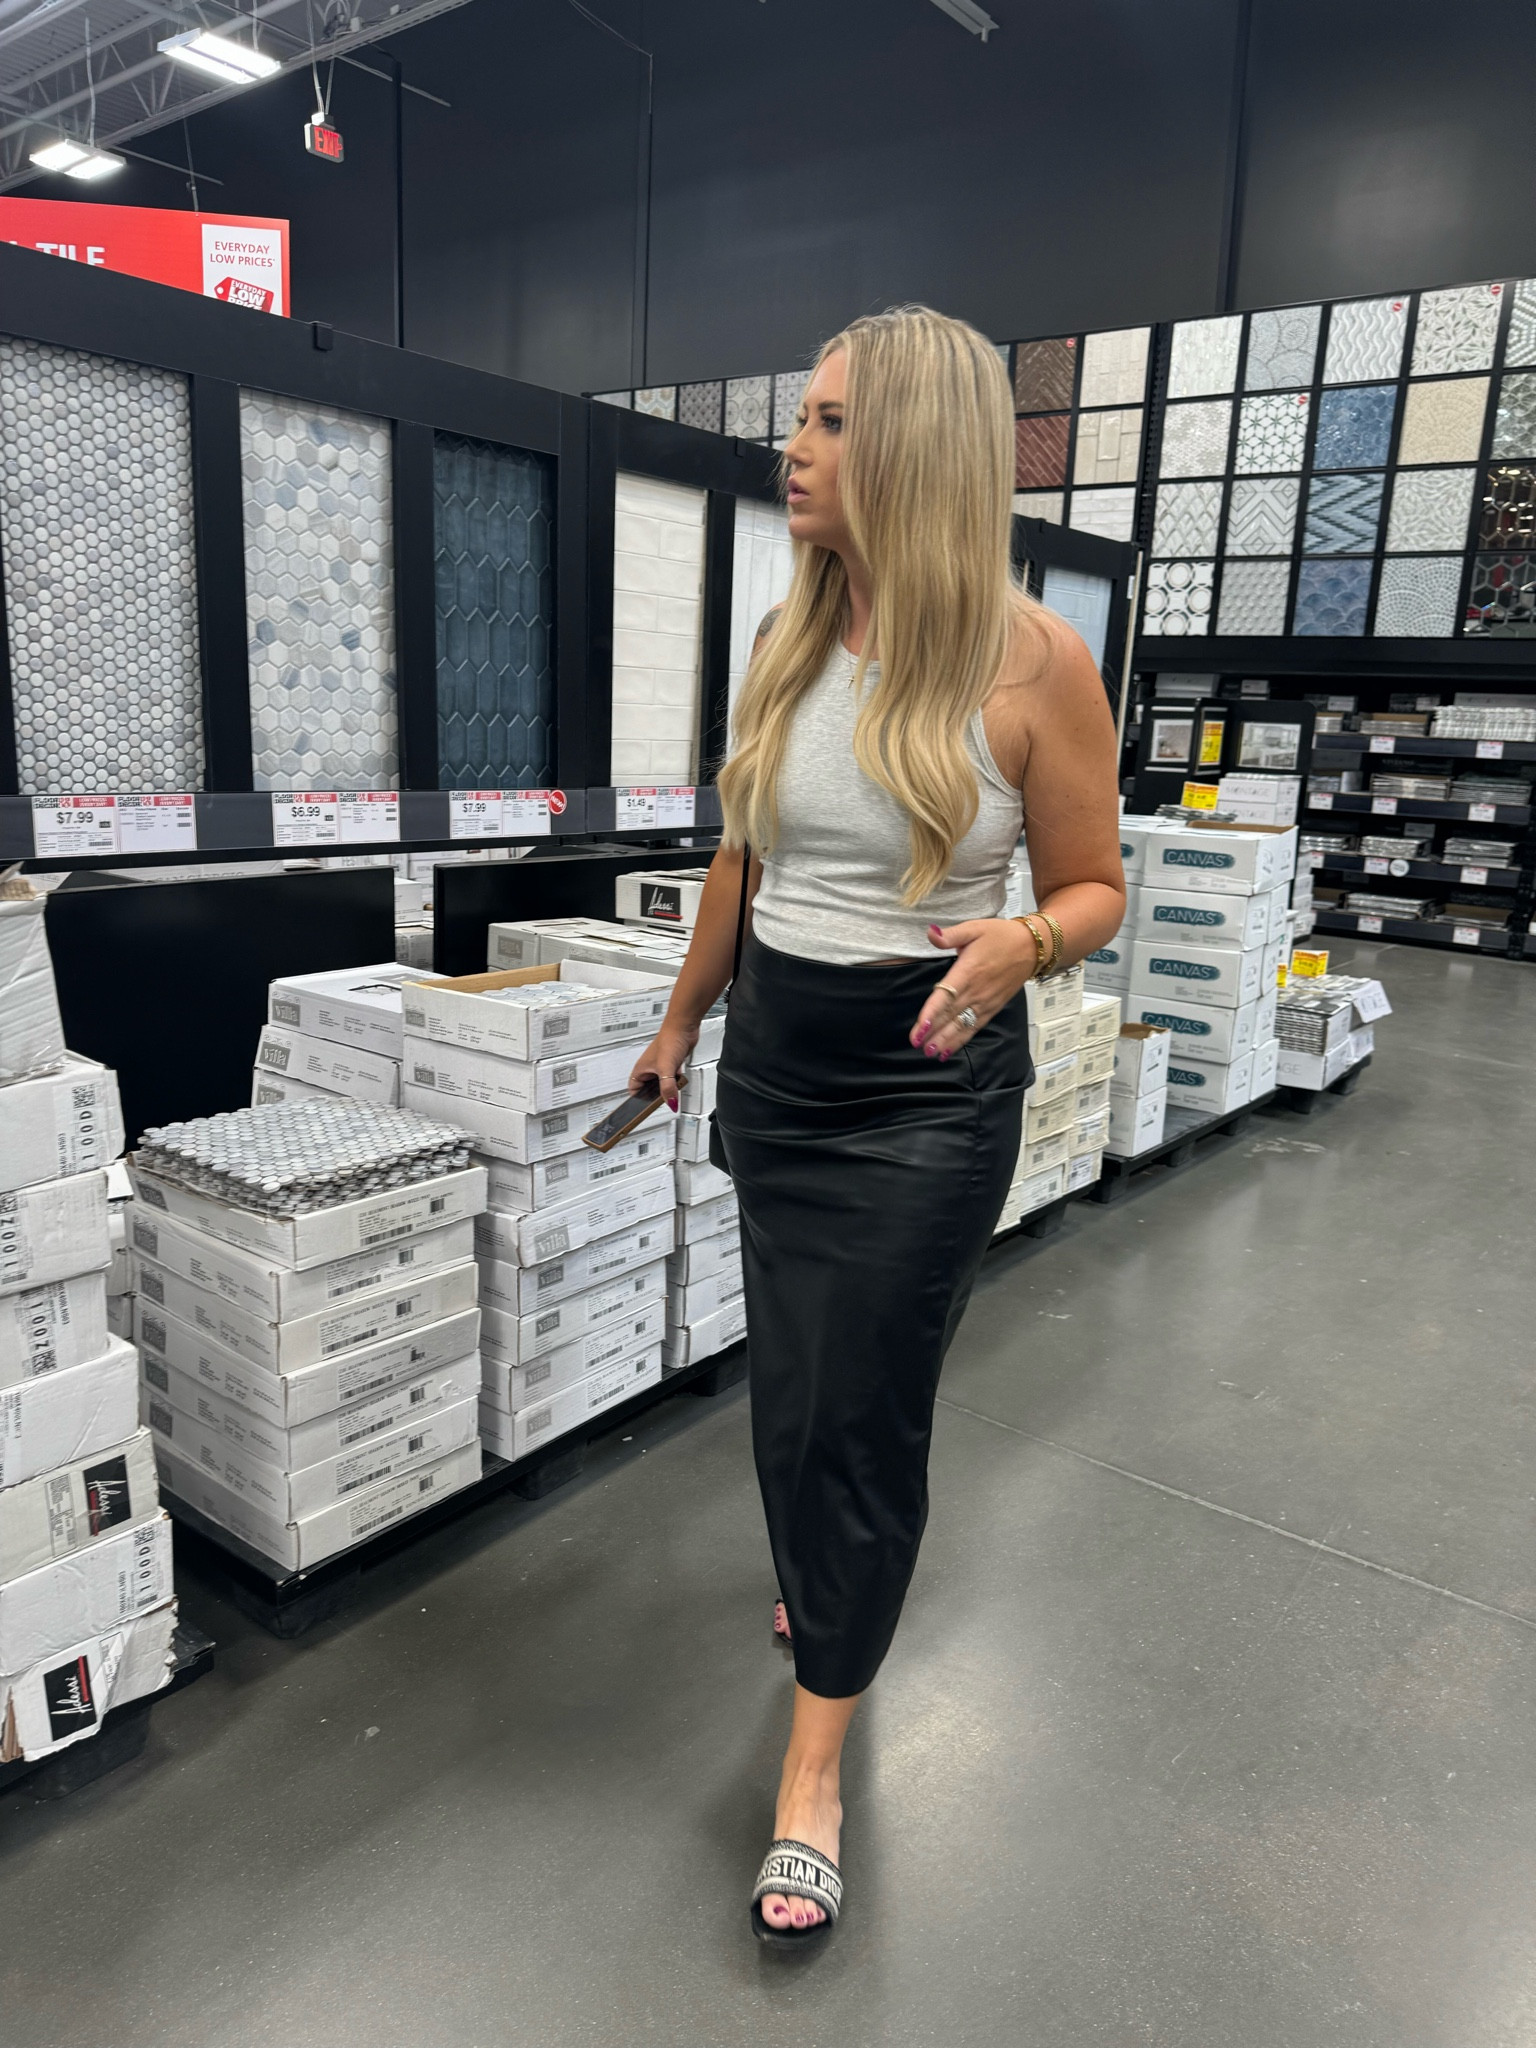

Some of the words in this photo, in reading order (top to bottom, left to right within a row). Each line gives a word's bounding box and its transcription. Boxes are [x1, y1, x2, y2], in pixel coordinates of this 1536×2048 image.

[314, 126, 343, 158] EXIT
[215, 241, 269, 254] EVERYDAY
[210, 253, 236, 264] LOW
[229, 286, 265, 306] LOW
[291, 806, 321, 818] $6.99
[463, 803, 487, 813] $7.99
[56, 811, 94, 824] $7.99
[1166, 850, 1225, 868] CANVAS
[1156, 907, 1217, 925] CANVAS
[1152, 960, 1212, 978] CANVAS
[274, 1004, 299, 1022] Villa
[263, 1047, 287, 1066] Villa
[537, 1232, 567, 1256] Villa
[50, 1675, 94, 1715] Adessi
